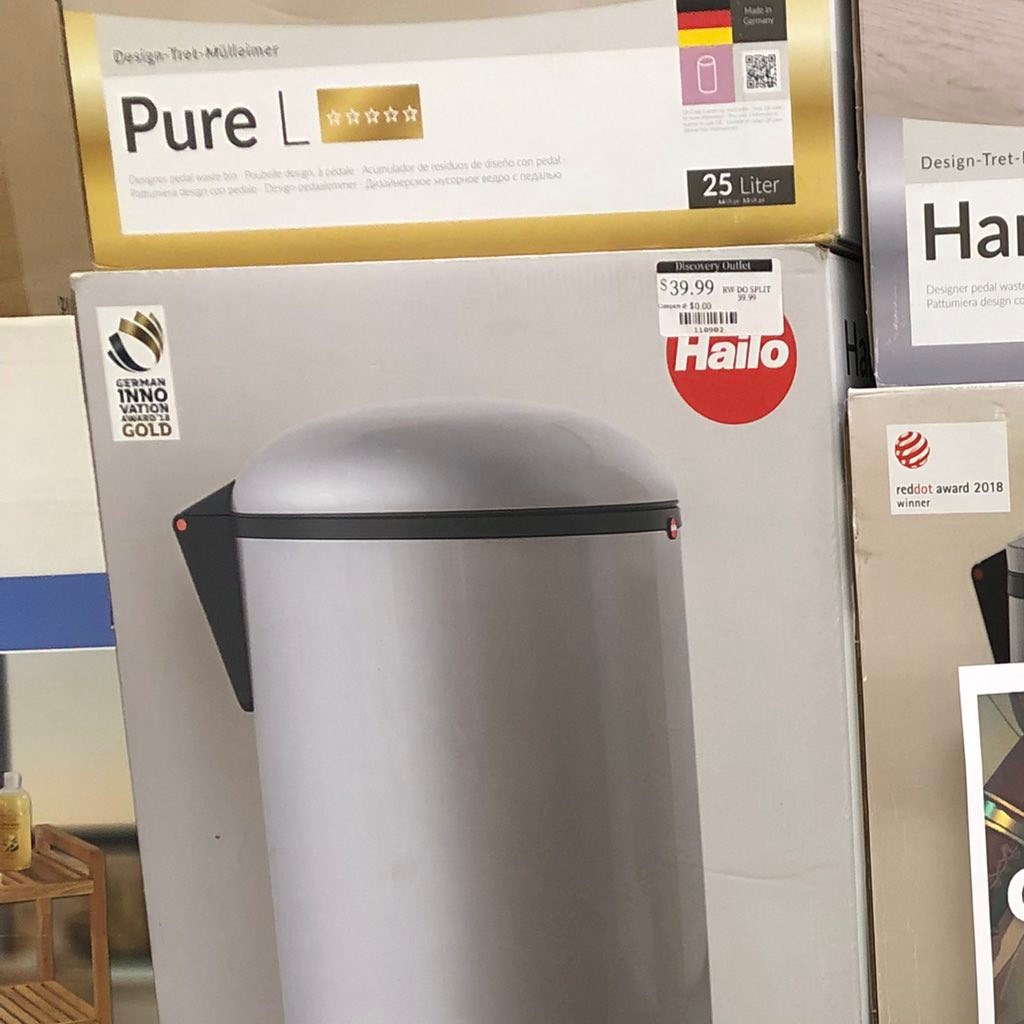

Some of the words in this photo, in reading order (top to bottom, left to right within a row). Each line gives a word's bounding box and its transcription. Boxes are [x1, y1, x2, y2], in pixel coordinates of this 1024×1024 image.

[744, 6, 762, 15] Made
[743, 16, 775, 26] Germany
[121, 95, 258, 153] Pure
[278, 89, 310, 146] L
[702, 172, 733, 197] 25
[740, 176, 780, 195] Liter
[675, 261, 720, 272] Discovery
[722, 260, 752, 270] Outlet
[659, 278, 714, 297] $39.99
[750, 285, 771, 293] SPLIT
[926, 284, 968, 296] Designer
[971, 282, 997, 294] pedal
[927, 296, 977, 309] Pattumiera
[980, 294, 1011, 307] design
[674, 336, 790, 372] Hailo
[116, 378, 166, 388] GERMAN
[118, 388, 168, 403] INNO
[119, 403, 169, 414] VATION
[121, 414, 156, 422] AWARD
[122, 423, 172, 437] GOLD
[896, 483, 933, 495] reddot
[936, 482, 970, 493] award
[974, 481, 1004, 493] 2018
[897, 498, 931, 508] winner
